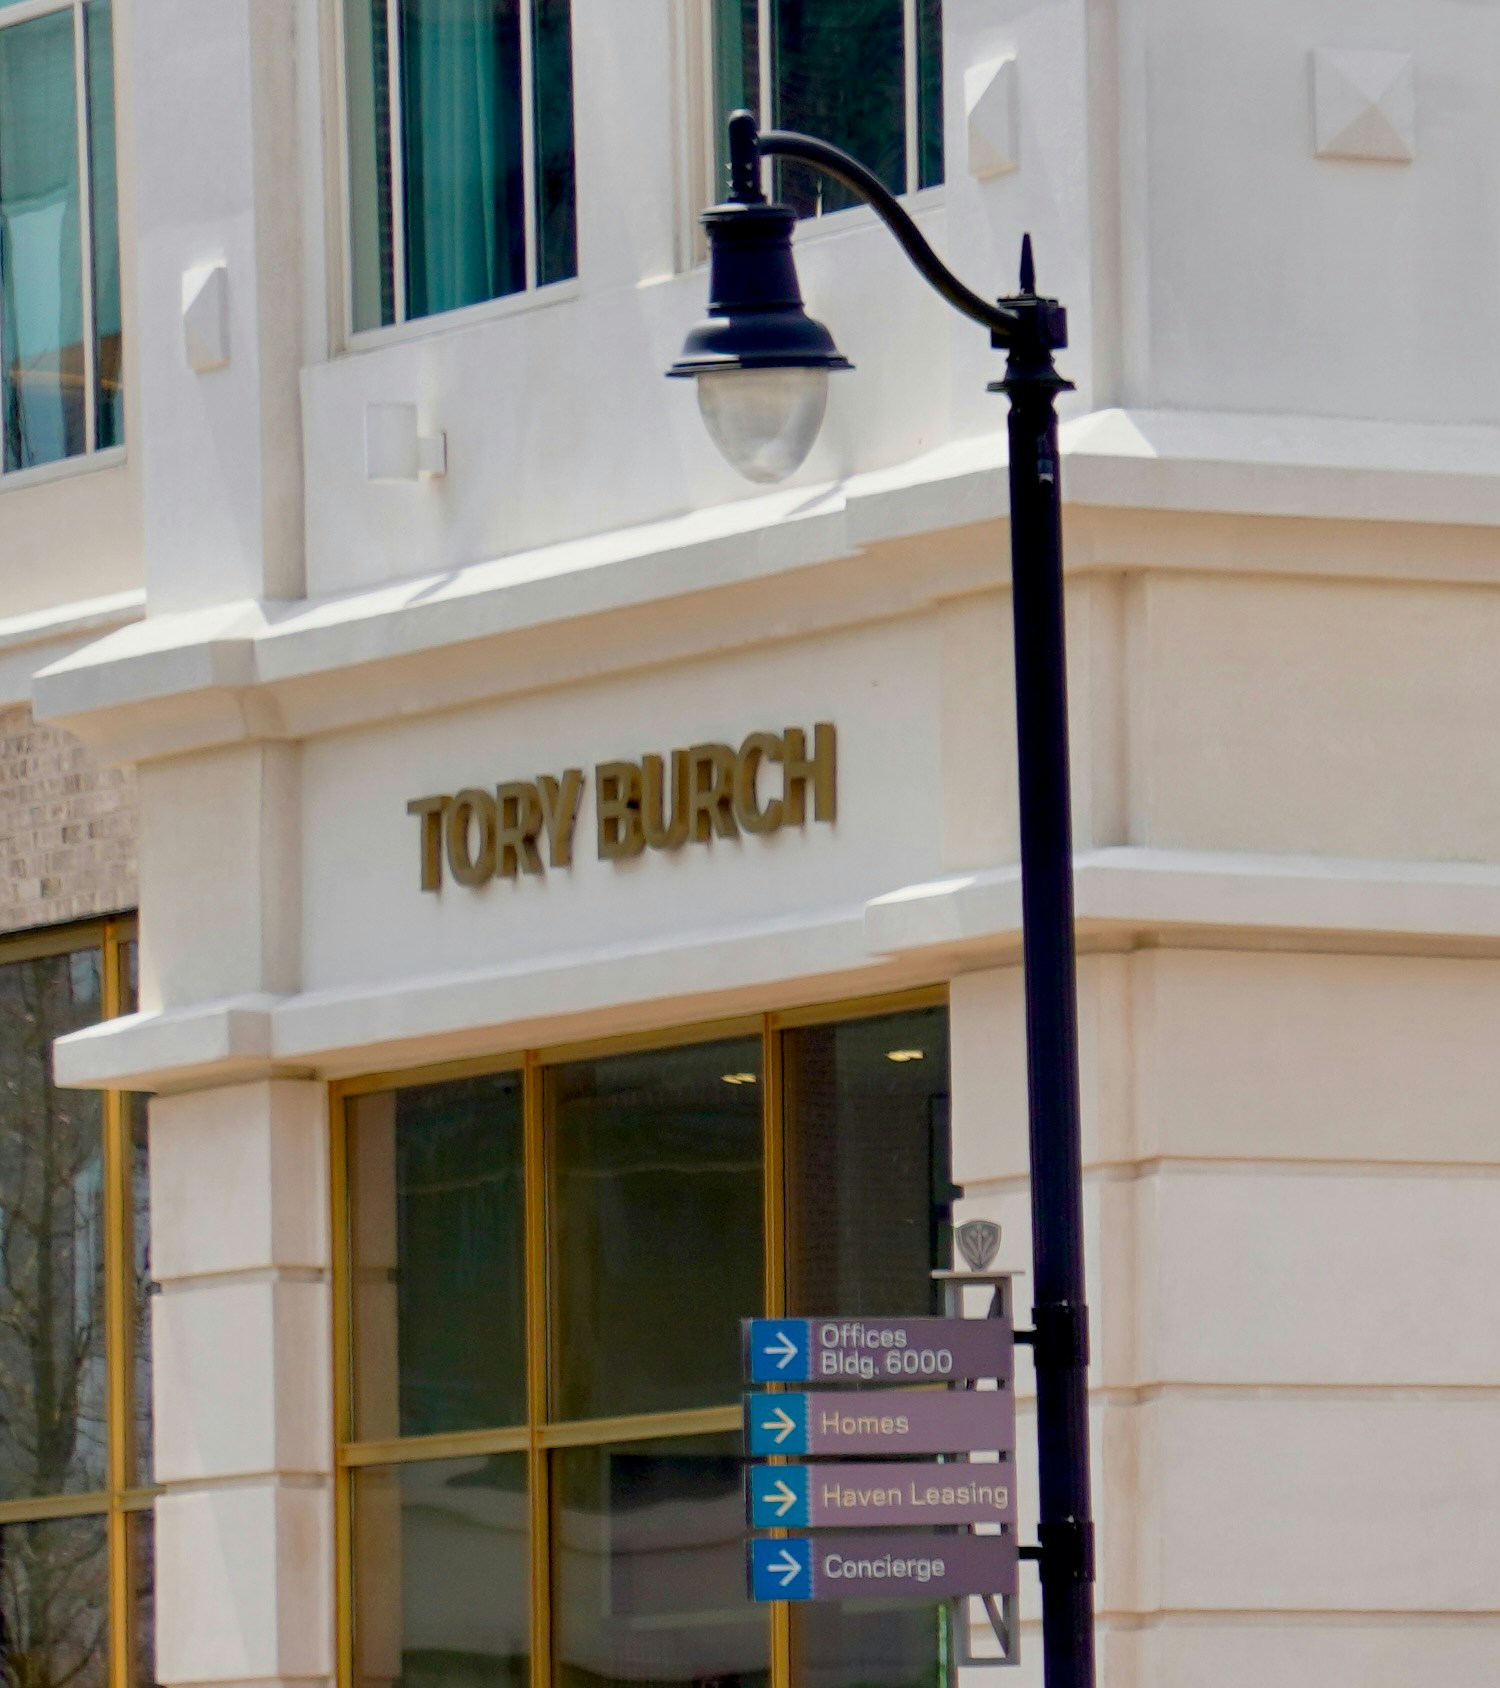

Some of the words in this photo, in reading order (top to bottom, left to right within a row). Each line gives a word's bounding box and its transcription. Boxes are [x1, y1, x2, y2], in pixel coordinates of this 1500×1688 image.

[407, 768, 586, 893] TORY
[595, 722, 838, 862] BURCH
[821, 1322, 908, 1349] Offices
[821, 1349, 880, 1380] Bldg.
[886, 1350, 953, 1374] 6000
[821, 1411, 910, 1436] Homes
[822, 1482, 902, 1508] Haven
[909, 1480, 1009, 1510] Leasing
[824, 1553, 946, 1583] Concierge
